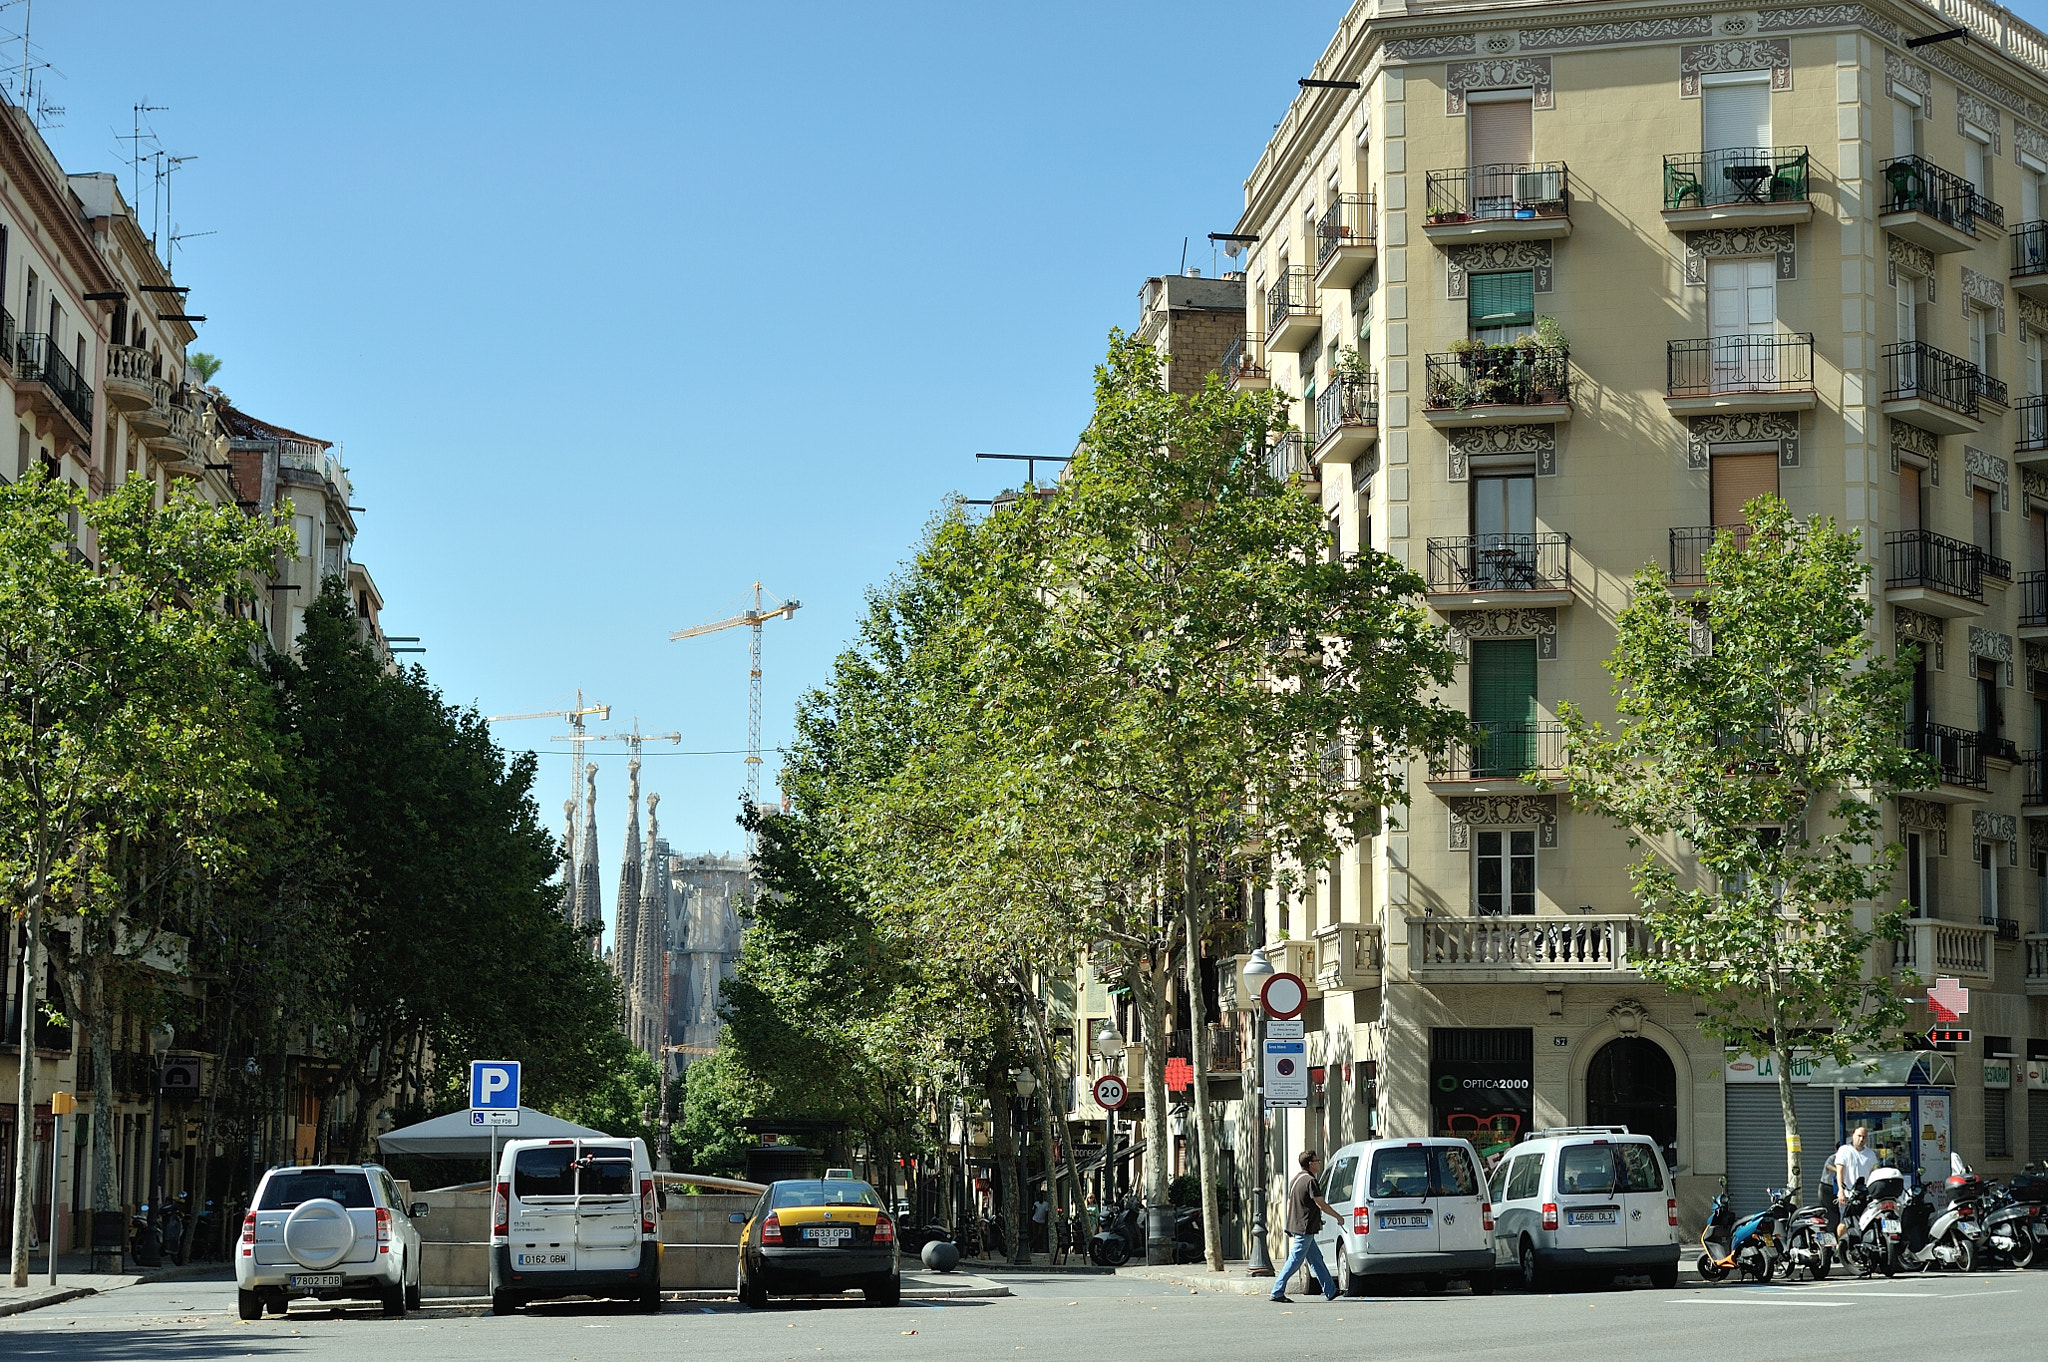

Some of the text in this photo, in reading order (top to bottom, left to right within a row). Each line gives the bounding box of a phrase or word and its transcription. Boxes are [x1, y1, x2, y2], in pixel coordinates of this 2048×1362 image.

[1555, 1038, 1566, 1046] 87
[1757, 1058, 1773, 1076] LA
[1984, 1066, 2009, 1082] RESTAURANT
[481, 1067, 510, 1104] P
[1462, 1079, 1529, 1089] OPTICA2000
[1101, 1086, 1120, 1098] 20
[1387, 1216, 1426, 1225] 7010 DBL
[1598, 1212, 1613, 1220] DLX
[809, 1229, 850, 1237] 6633 GPB
[821, 1237, 836, 1246] SP
[525, 1254, 566, 1264] 0162 GBM
[296, 1276, 340, 1285] 7802 FDB
